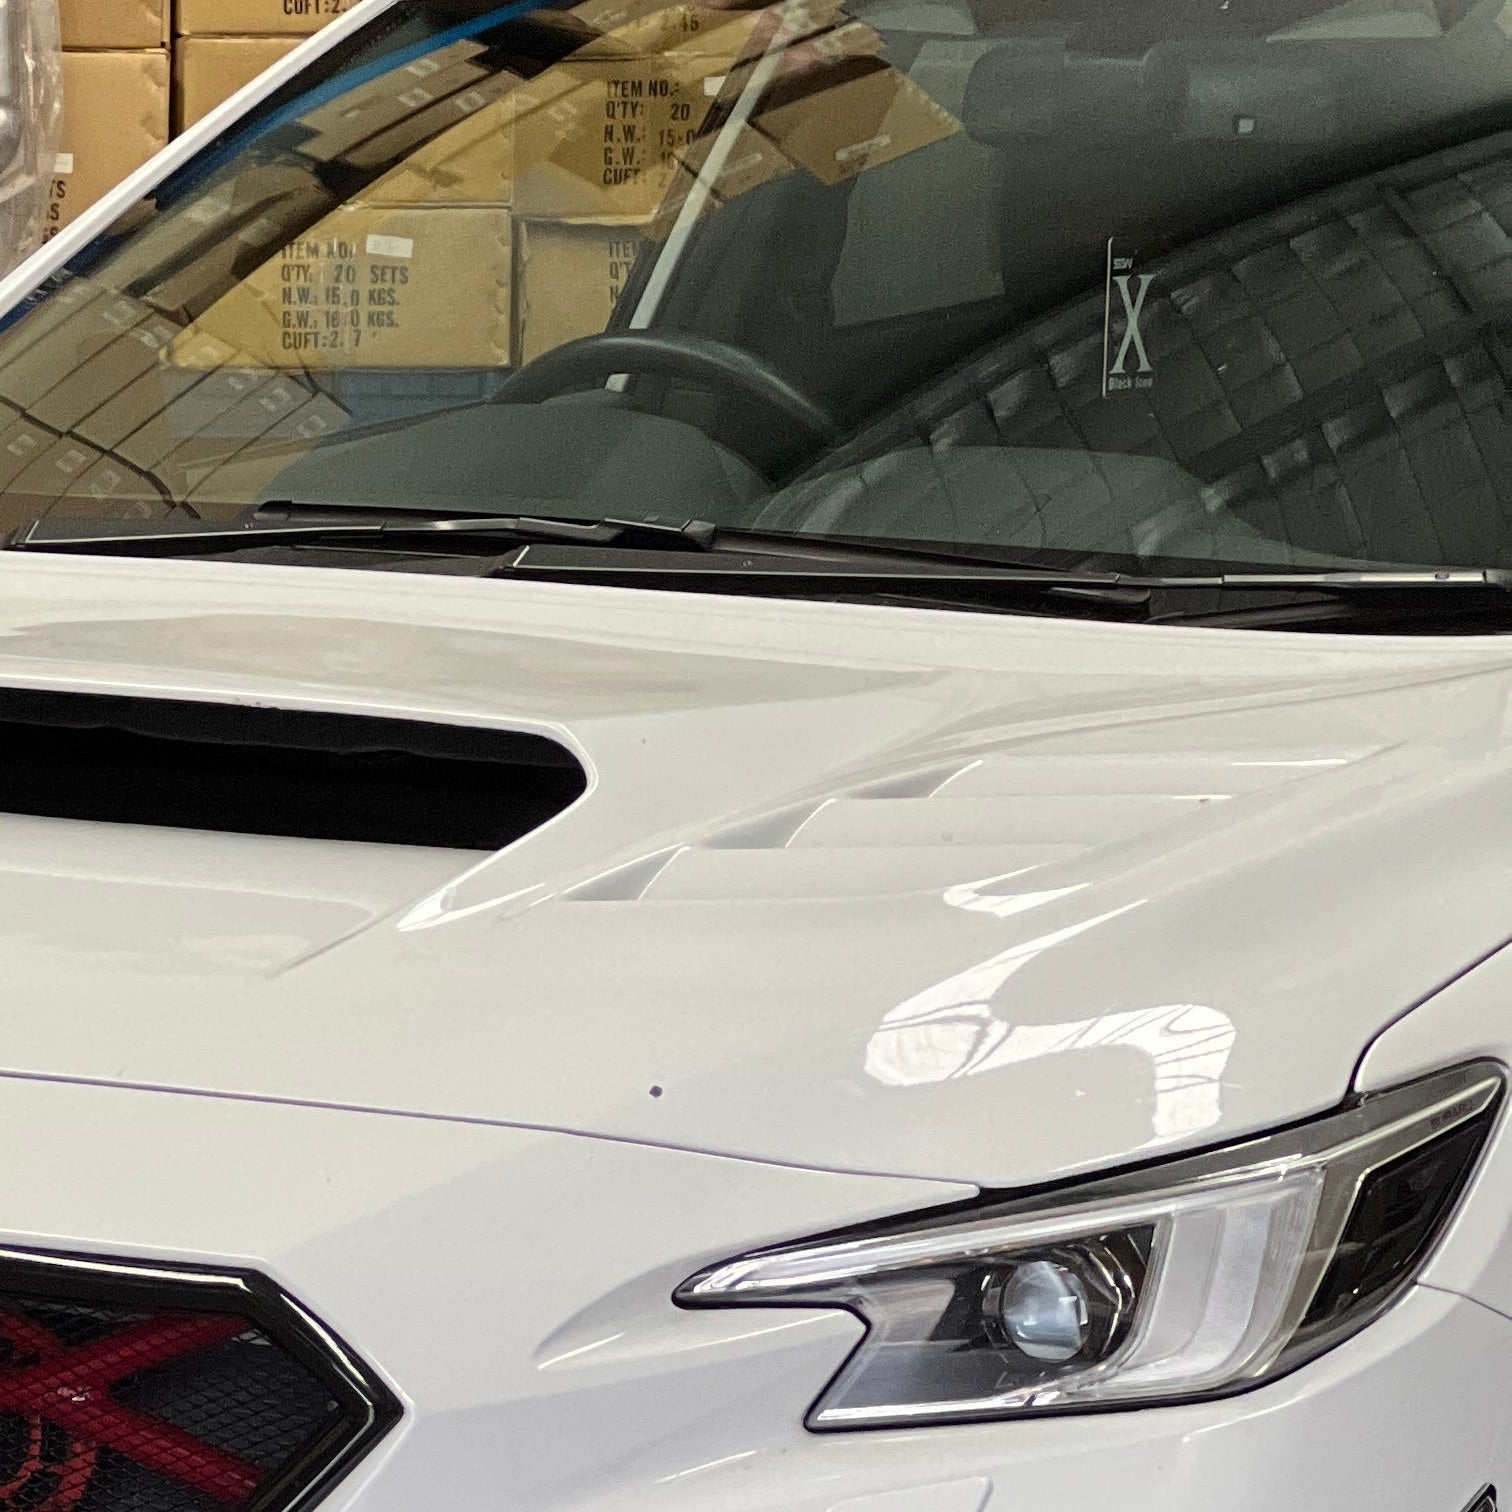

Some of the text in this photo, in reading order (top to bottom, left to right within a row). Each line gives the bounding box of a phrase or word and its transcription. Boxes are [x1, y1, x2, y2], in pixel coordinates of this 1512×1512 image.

[670, 104, 690, 121] 20
[334, 264, 357, 284] 20
[370, 264, 409, 284] SETS
[368, 288, 400, 306] KGS.
[367, 311, 400, 328] KGS.
[1109, 274, 1156, 374] X
